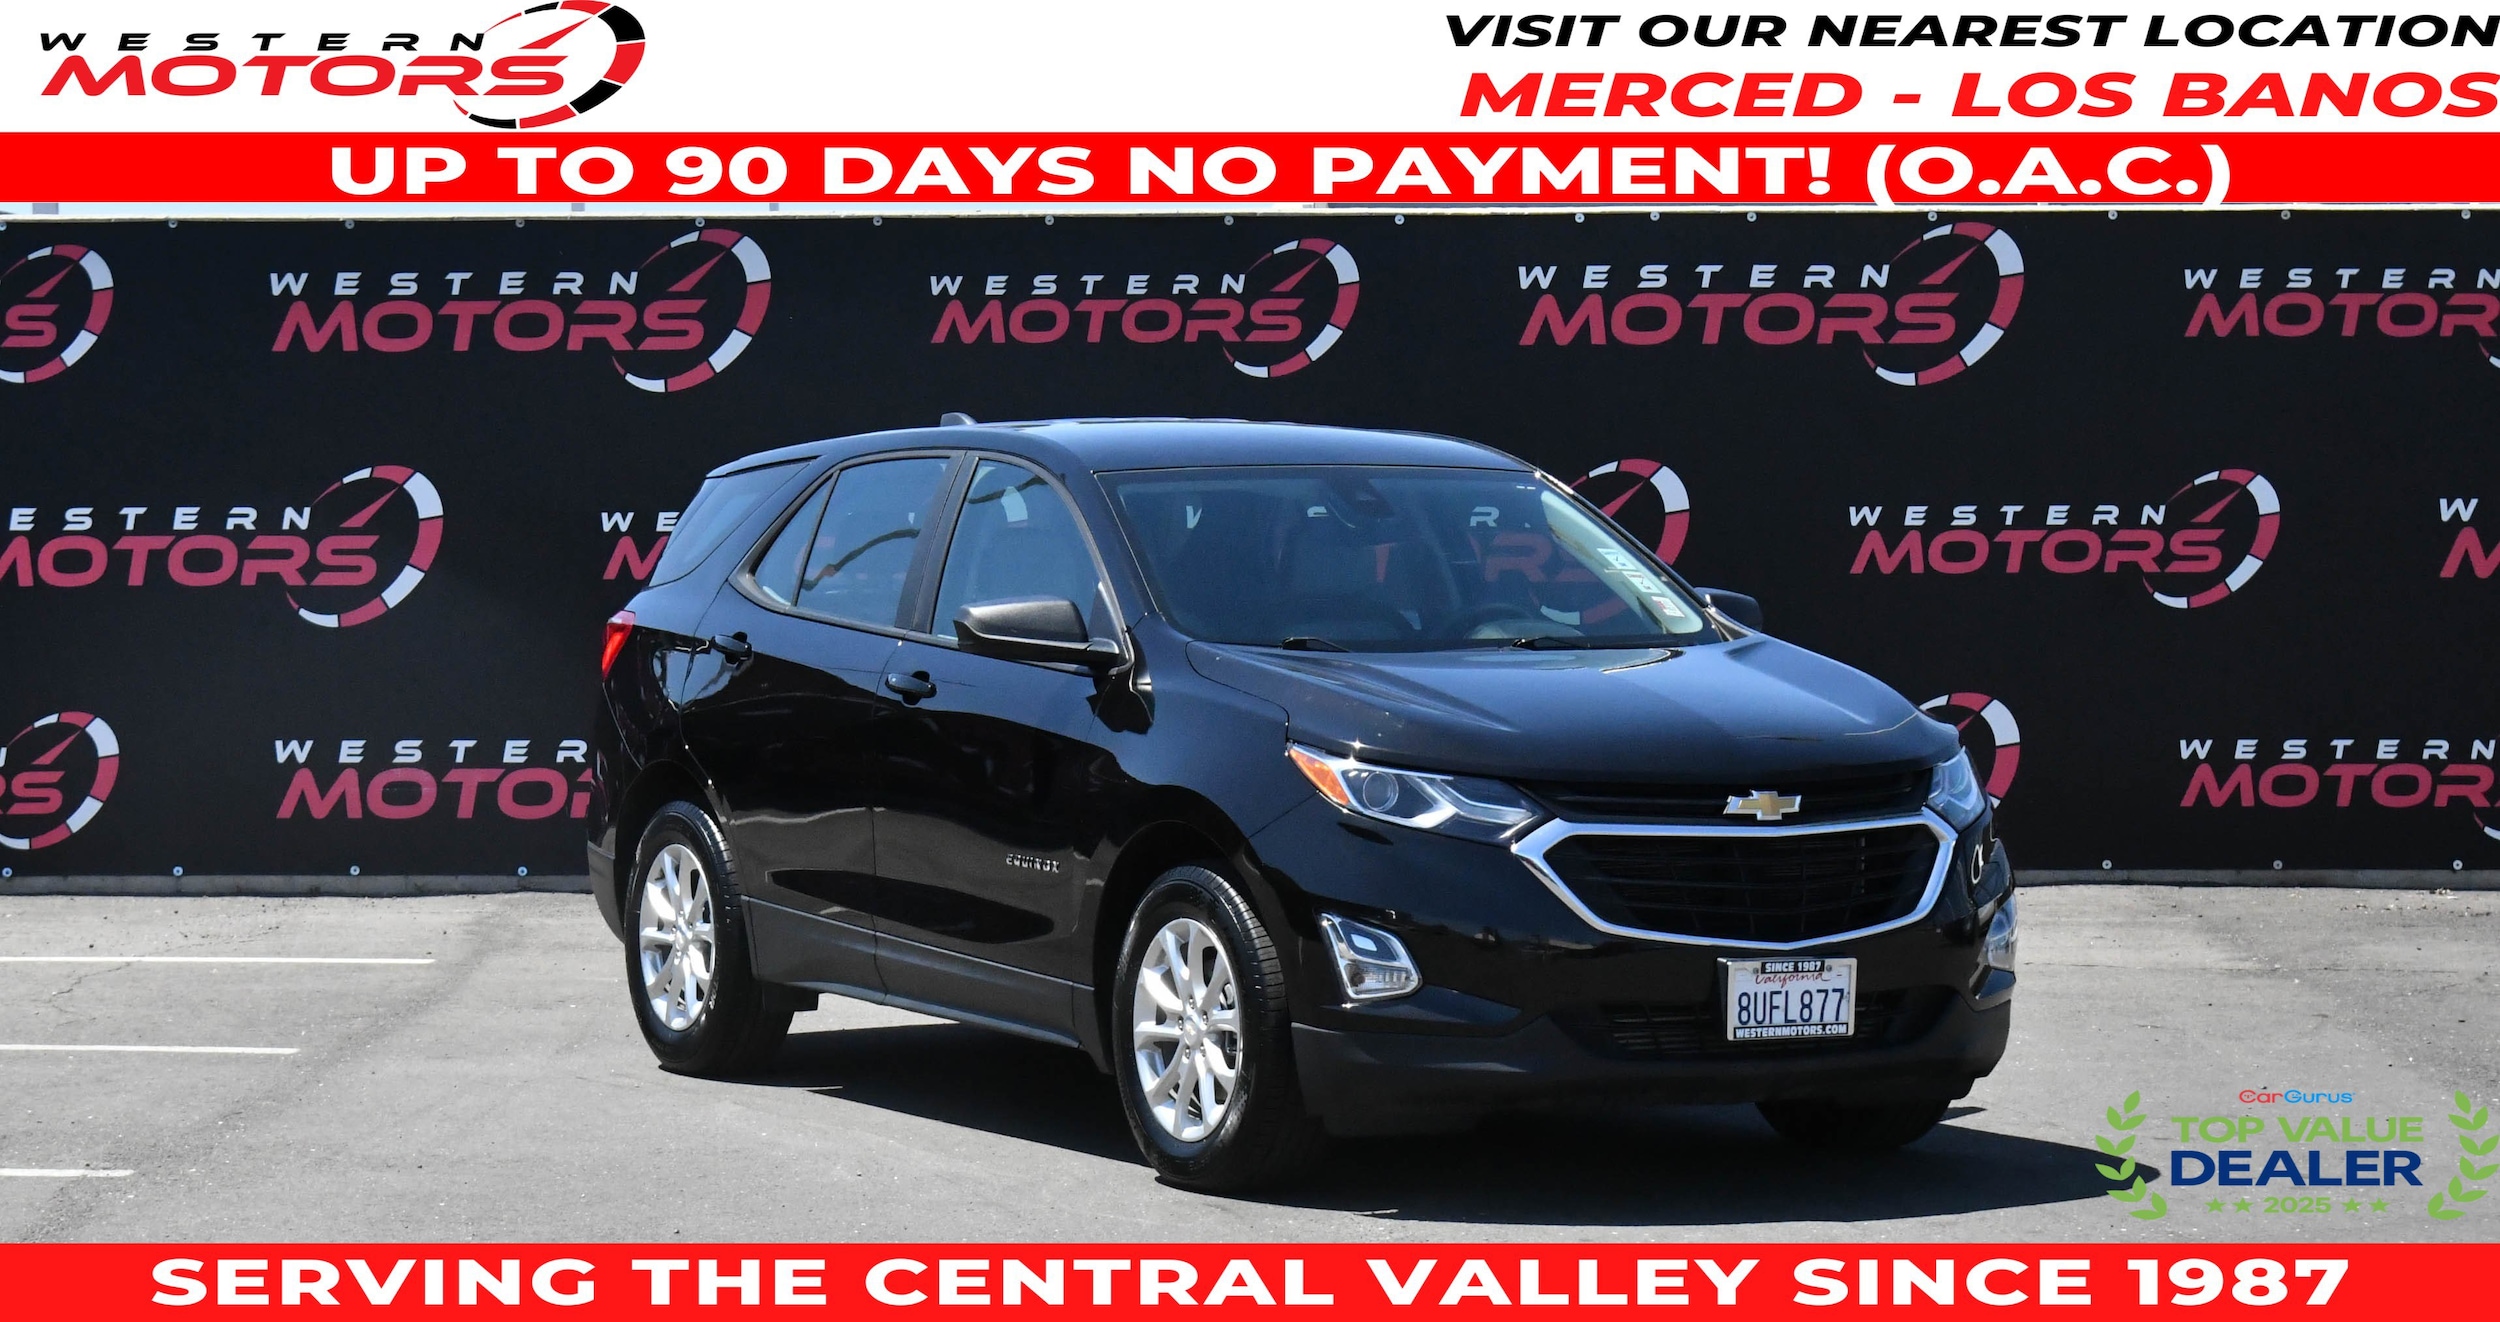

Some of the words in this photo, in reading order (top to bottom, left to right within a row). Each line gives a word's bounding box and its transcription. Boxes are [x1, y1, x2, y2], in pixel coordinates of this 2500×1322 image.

[270, 272, 638, 296] WESTERN
[930, 274, 1246, 295] WESTERN
[1519, 265, 1890, 289] WESTERN
[2185, 268, 2500, 289] WESTERN
[272, 299, 706, 352] MOTORS
[932, 298, 1305, 344] MOTORS
[1519, 293, 1958, 346] MOTORS
[1849, 505, 2166, 526] WESTERN
[1850, 529, 2225, 574] MOTORS
[2180, 739, 2496, 760] WESTERN
[2180, 763, 2500, 808] MOTOR
[1765, 962, 1795, 972] SINCE
[1798, 961, 1822, 971] 1987
[1737, 988, 1845, 1025] 8UFL877
[1735, 1024, 1848, 1038] WESTERNMOTORS.COM
